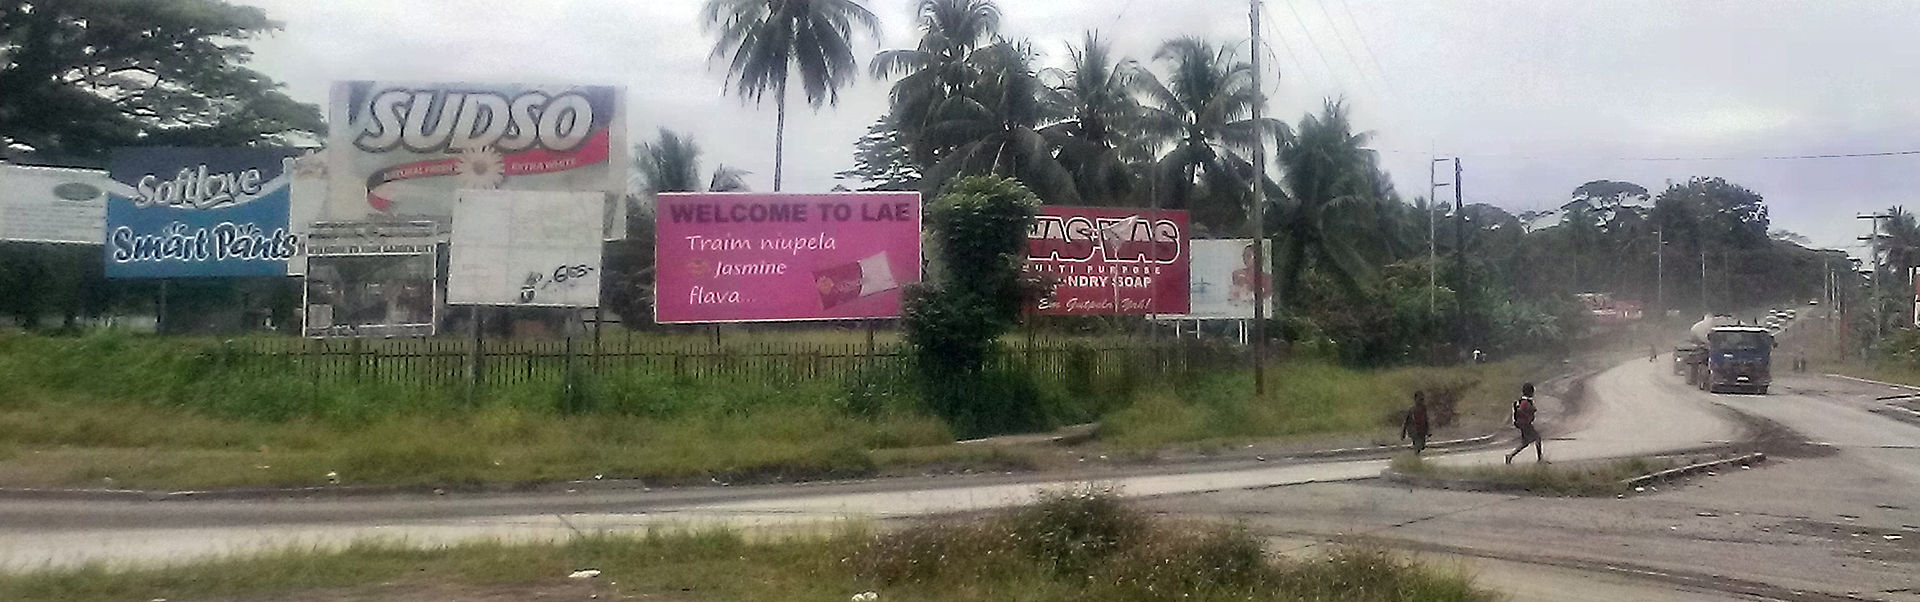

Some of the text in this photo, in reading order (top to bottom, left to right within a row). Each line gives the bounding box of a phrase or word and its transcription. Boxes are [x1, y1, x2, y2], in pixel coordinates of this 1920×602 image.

[353, 90, 595, 154] SUDSO
[134, 163, 262, 207] Softlove
[670, 202, 911, 223] WELCOME TO LAE
[113, 221, 298, 263] Smart Pants
[686, 231, 836, 255] Traim niupela
[713, 261, 788, 278] Jasmine
[1111, 275, 1152, 289] SOAP
